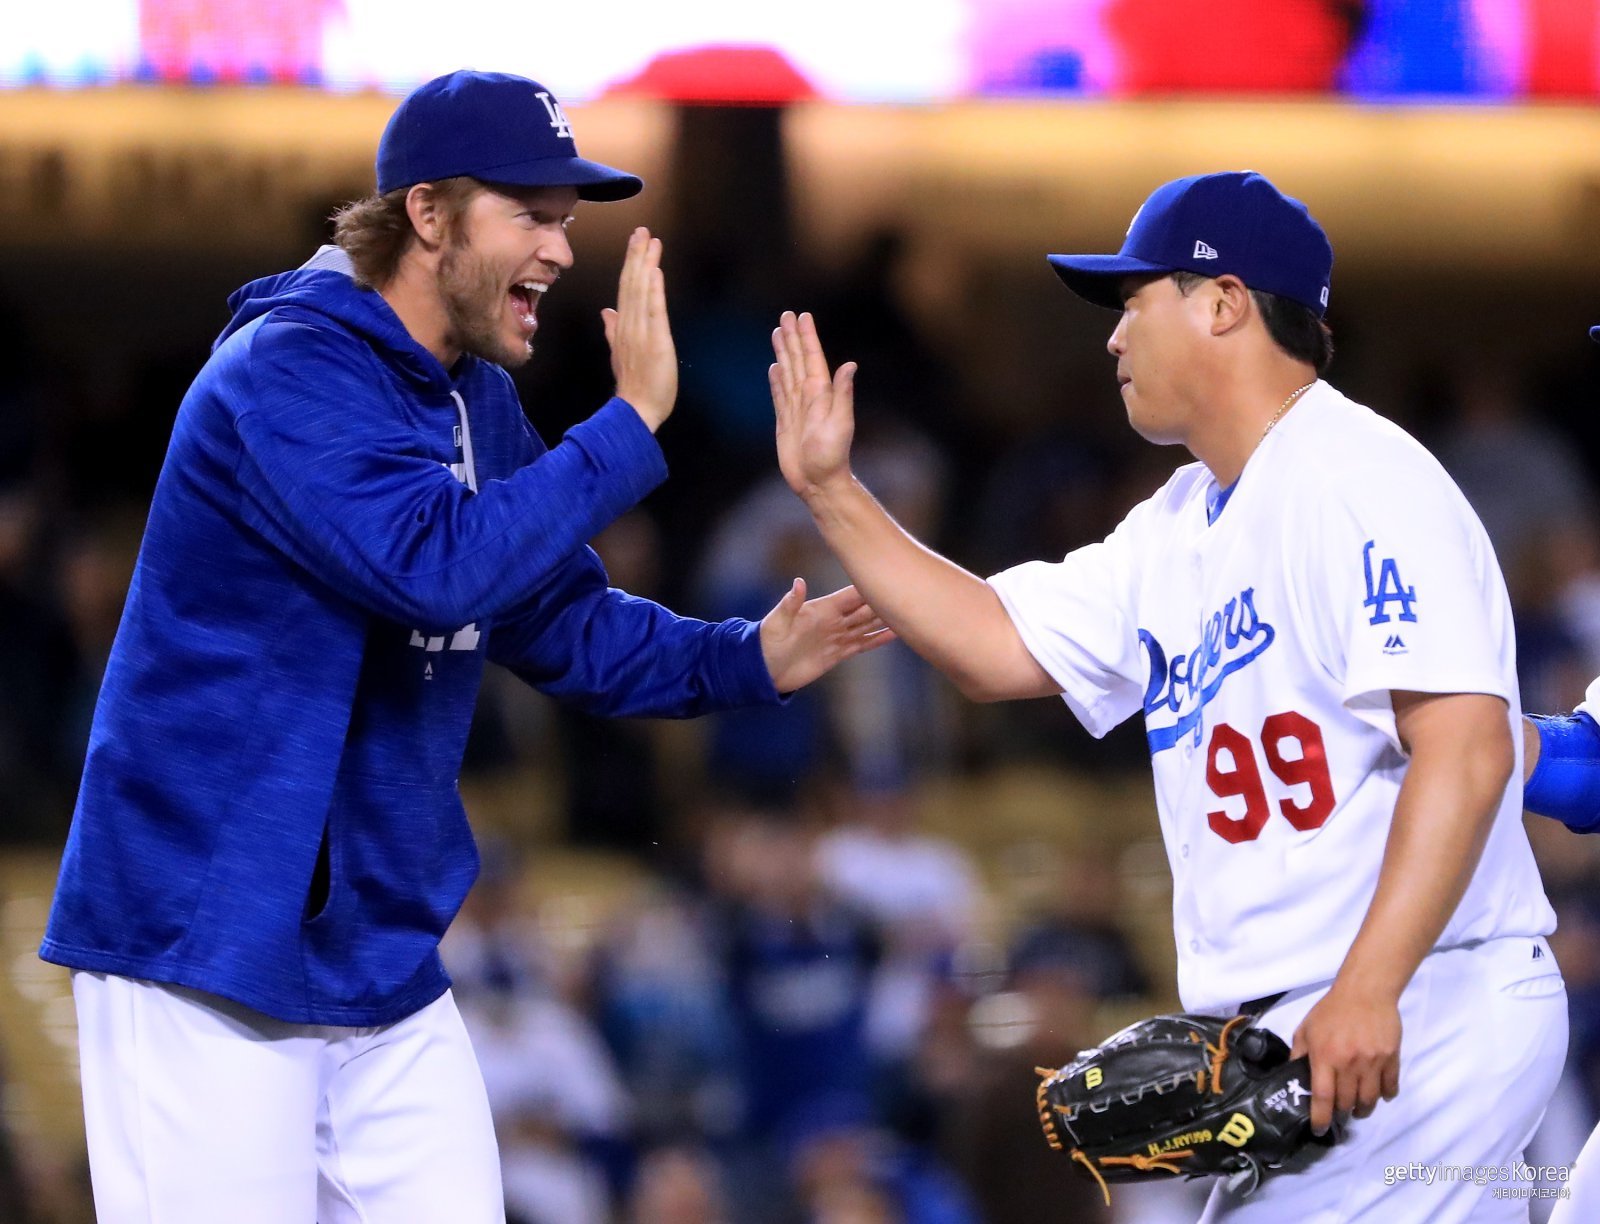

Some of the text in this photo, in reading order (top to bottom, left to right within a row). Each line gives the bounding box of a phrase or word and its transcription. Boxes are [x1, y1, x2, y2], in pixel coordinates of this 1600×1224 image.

[534, 91, 575, 138] LA
[1363, 539, 1417, 626] LA
[1206, 710, 1337, 844] 99
